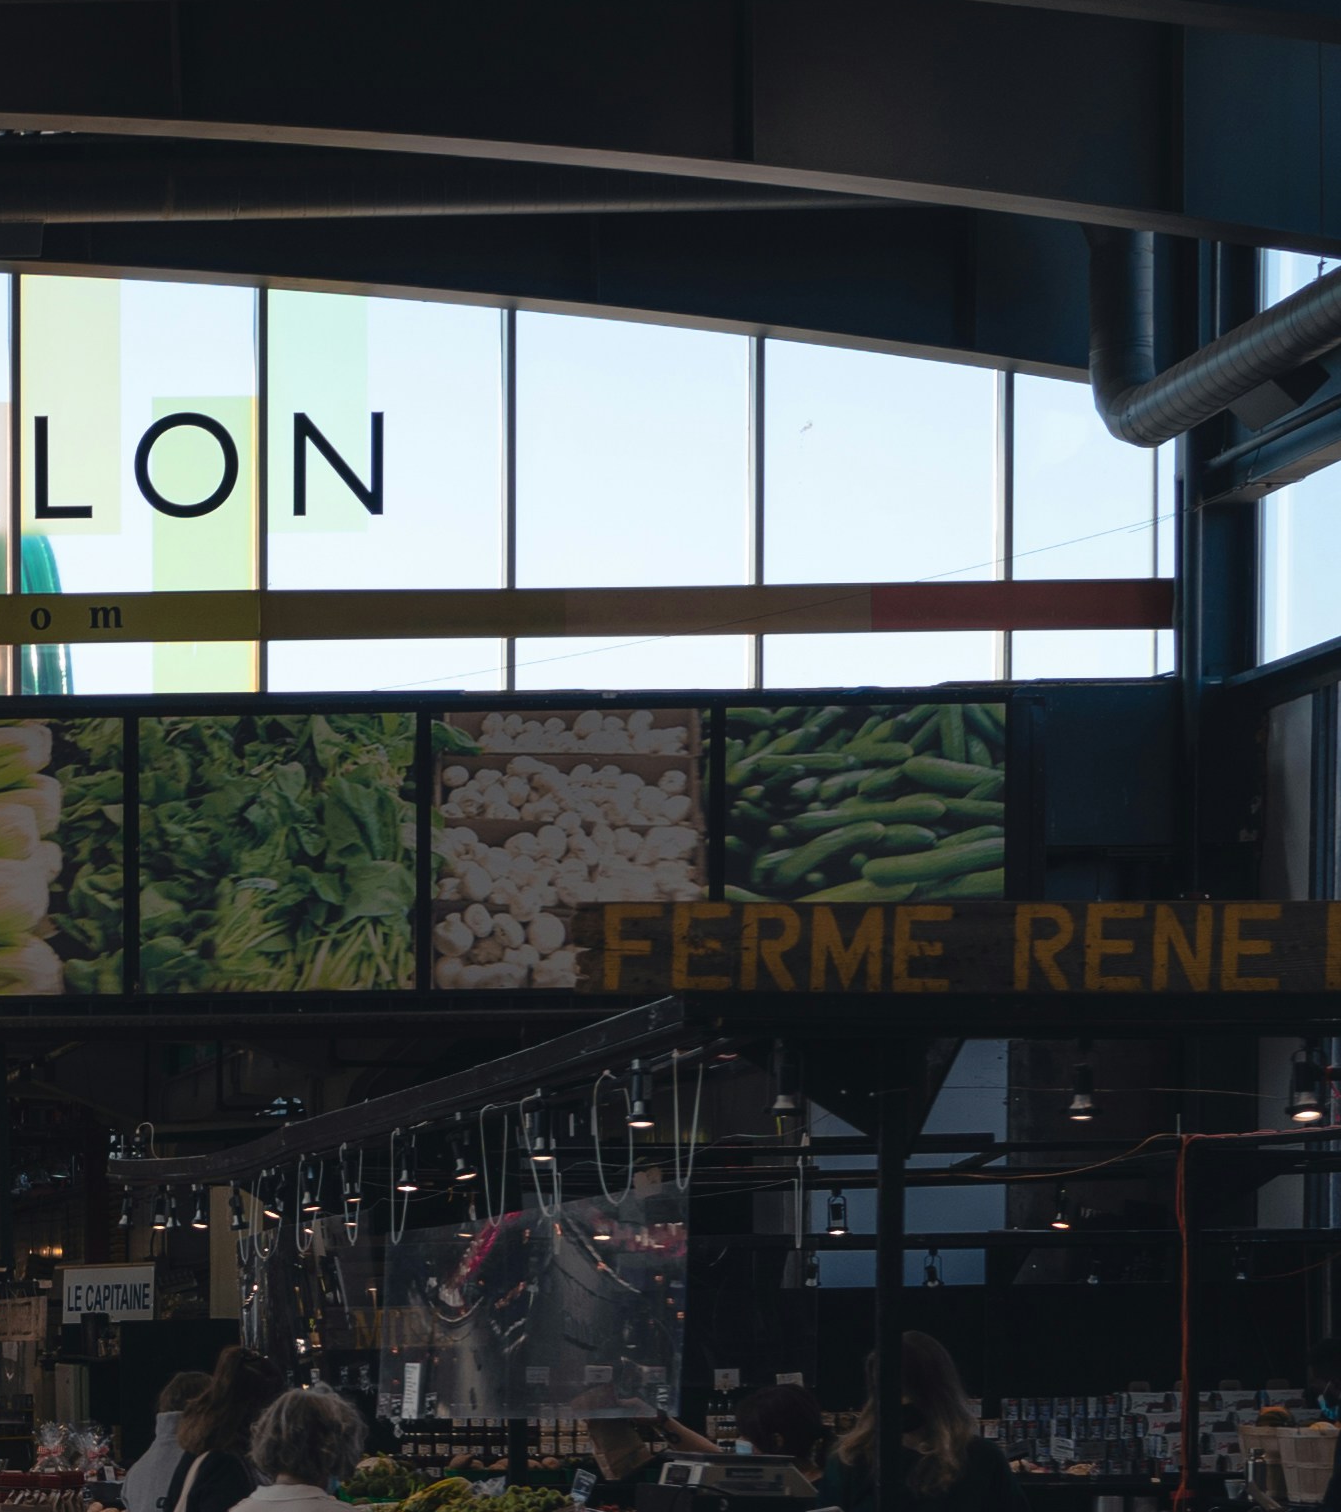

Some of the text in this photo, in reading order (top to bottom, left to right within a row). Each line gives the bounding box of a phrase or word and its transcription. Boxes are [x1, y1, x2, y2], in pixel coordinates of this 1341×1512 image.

[601, 902, 956, 993] FERME
[1012, 902, 1284, 993] RENE
[67, 1283, 150, 1312] LE CAPITAINE
